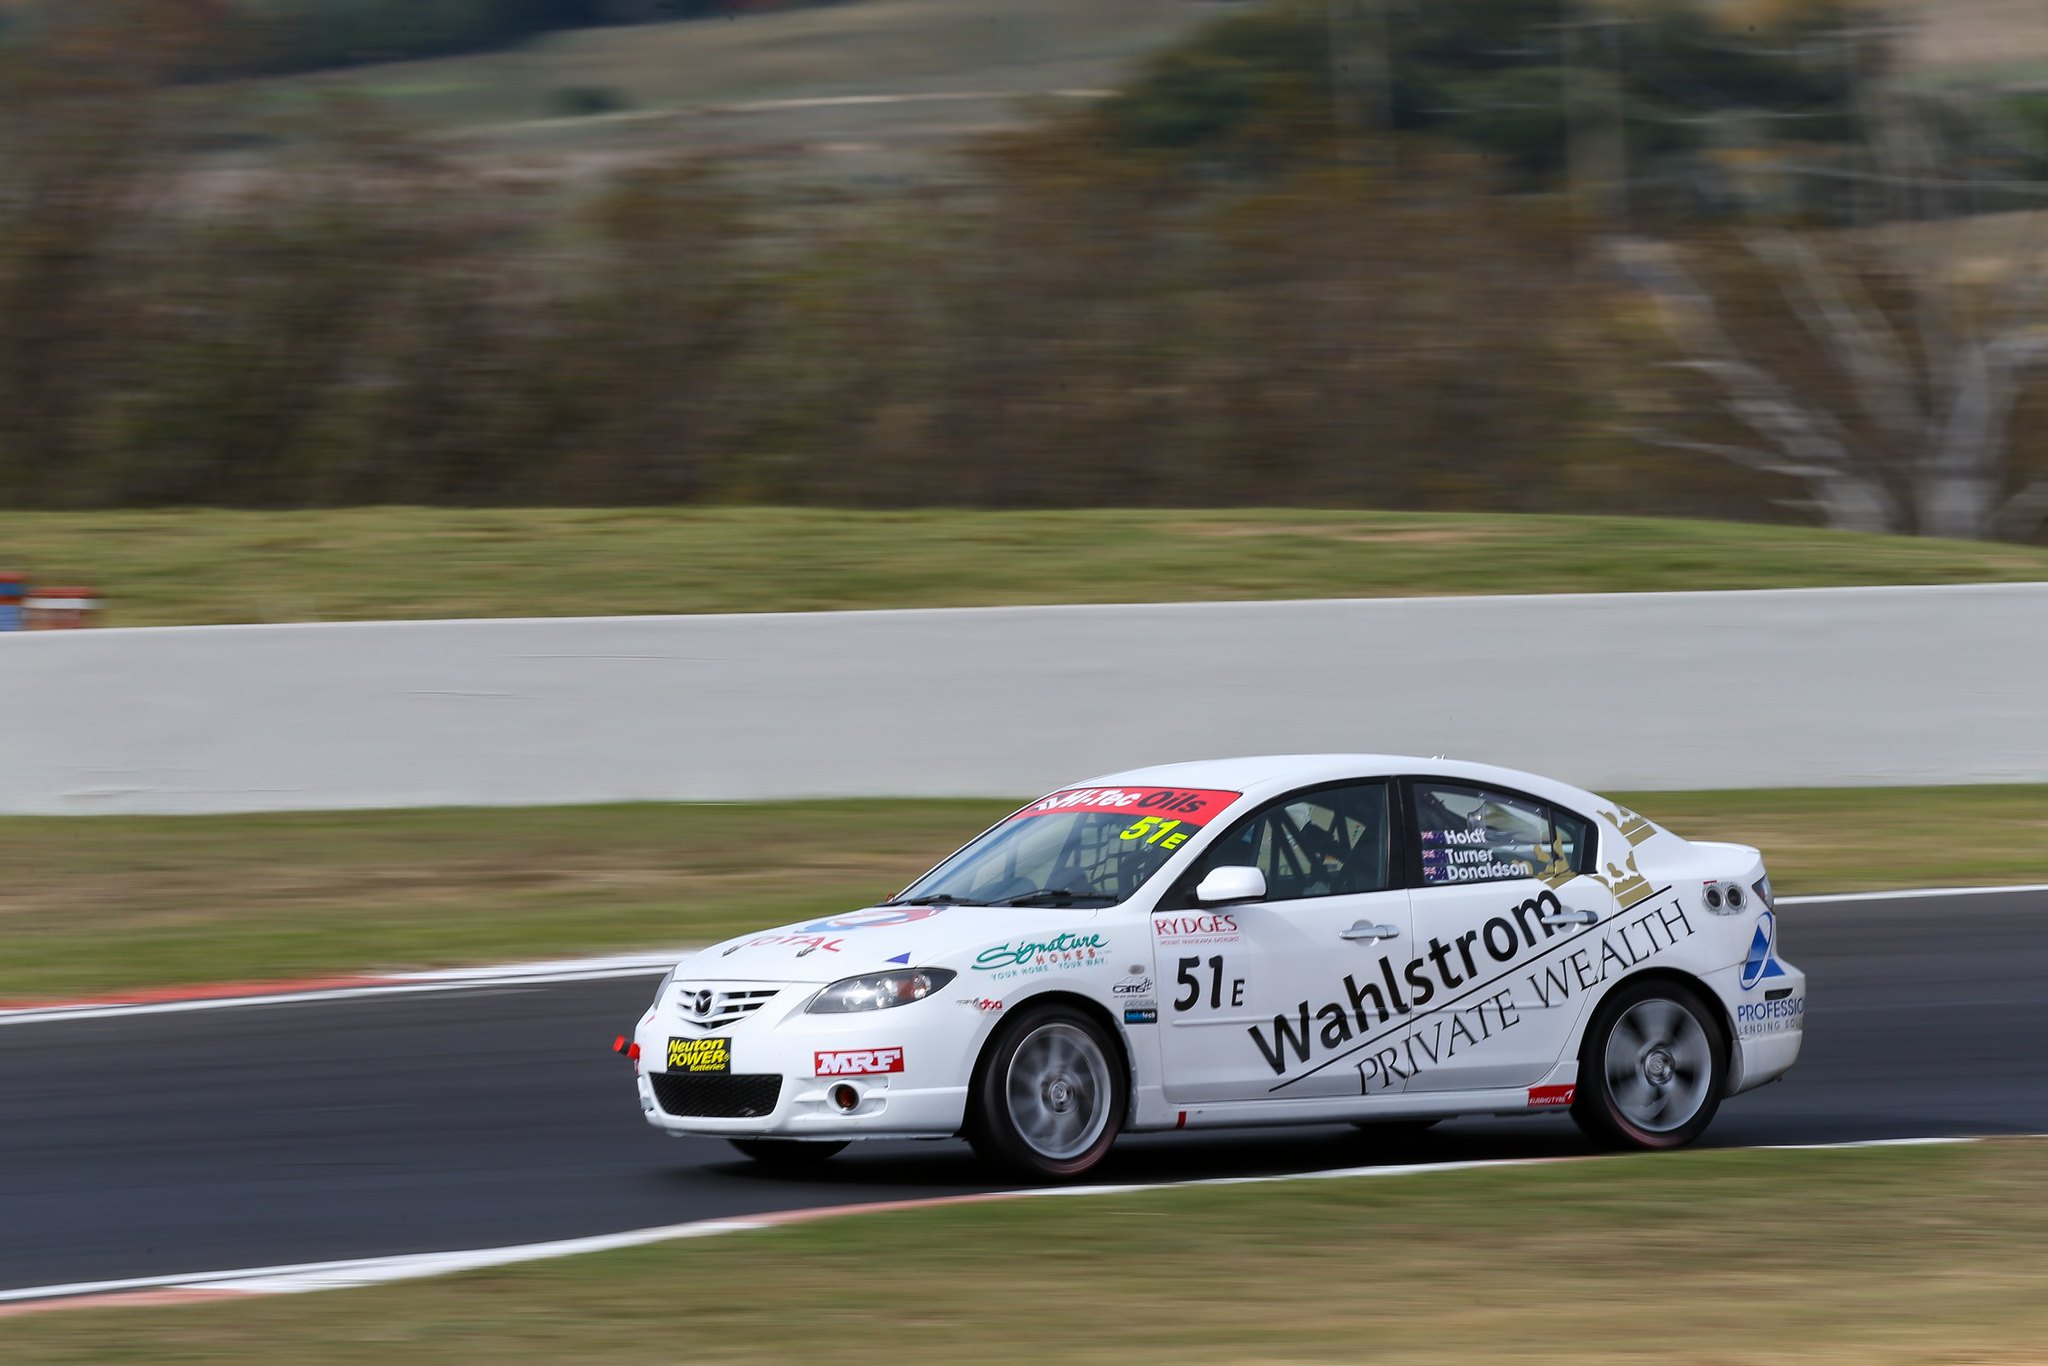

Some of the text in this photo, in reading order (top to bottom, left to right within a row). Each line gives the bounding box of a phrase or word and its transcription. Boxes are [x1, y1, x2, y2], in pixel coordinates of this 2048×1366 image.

[1053, 788, 1207, 814] Hi-Tec Oils
[1119, 815, 1189, 850] 51 E
[1444, 848, 1494, 865] Turner
[1446, 860, 1531, 881] Donaldson
[1154, 914, 1239, 936] RYDGES
[970, 932, 1110, 970] Signature
[1173, 954, 1246, 1012] 51 E
[1247, 890, 1569, 1076] Wahlstrom
[1354, 899, 1696, 1096] PRIVATE WEALTH
[1739, 1020, 1782, 1036] LENDING
[668, 1038, 726, 1055] Neuton
[689, 1062, 727, 1073] Batteries
[816, 1048, 901, 1075] MRF
